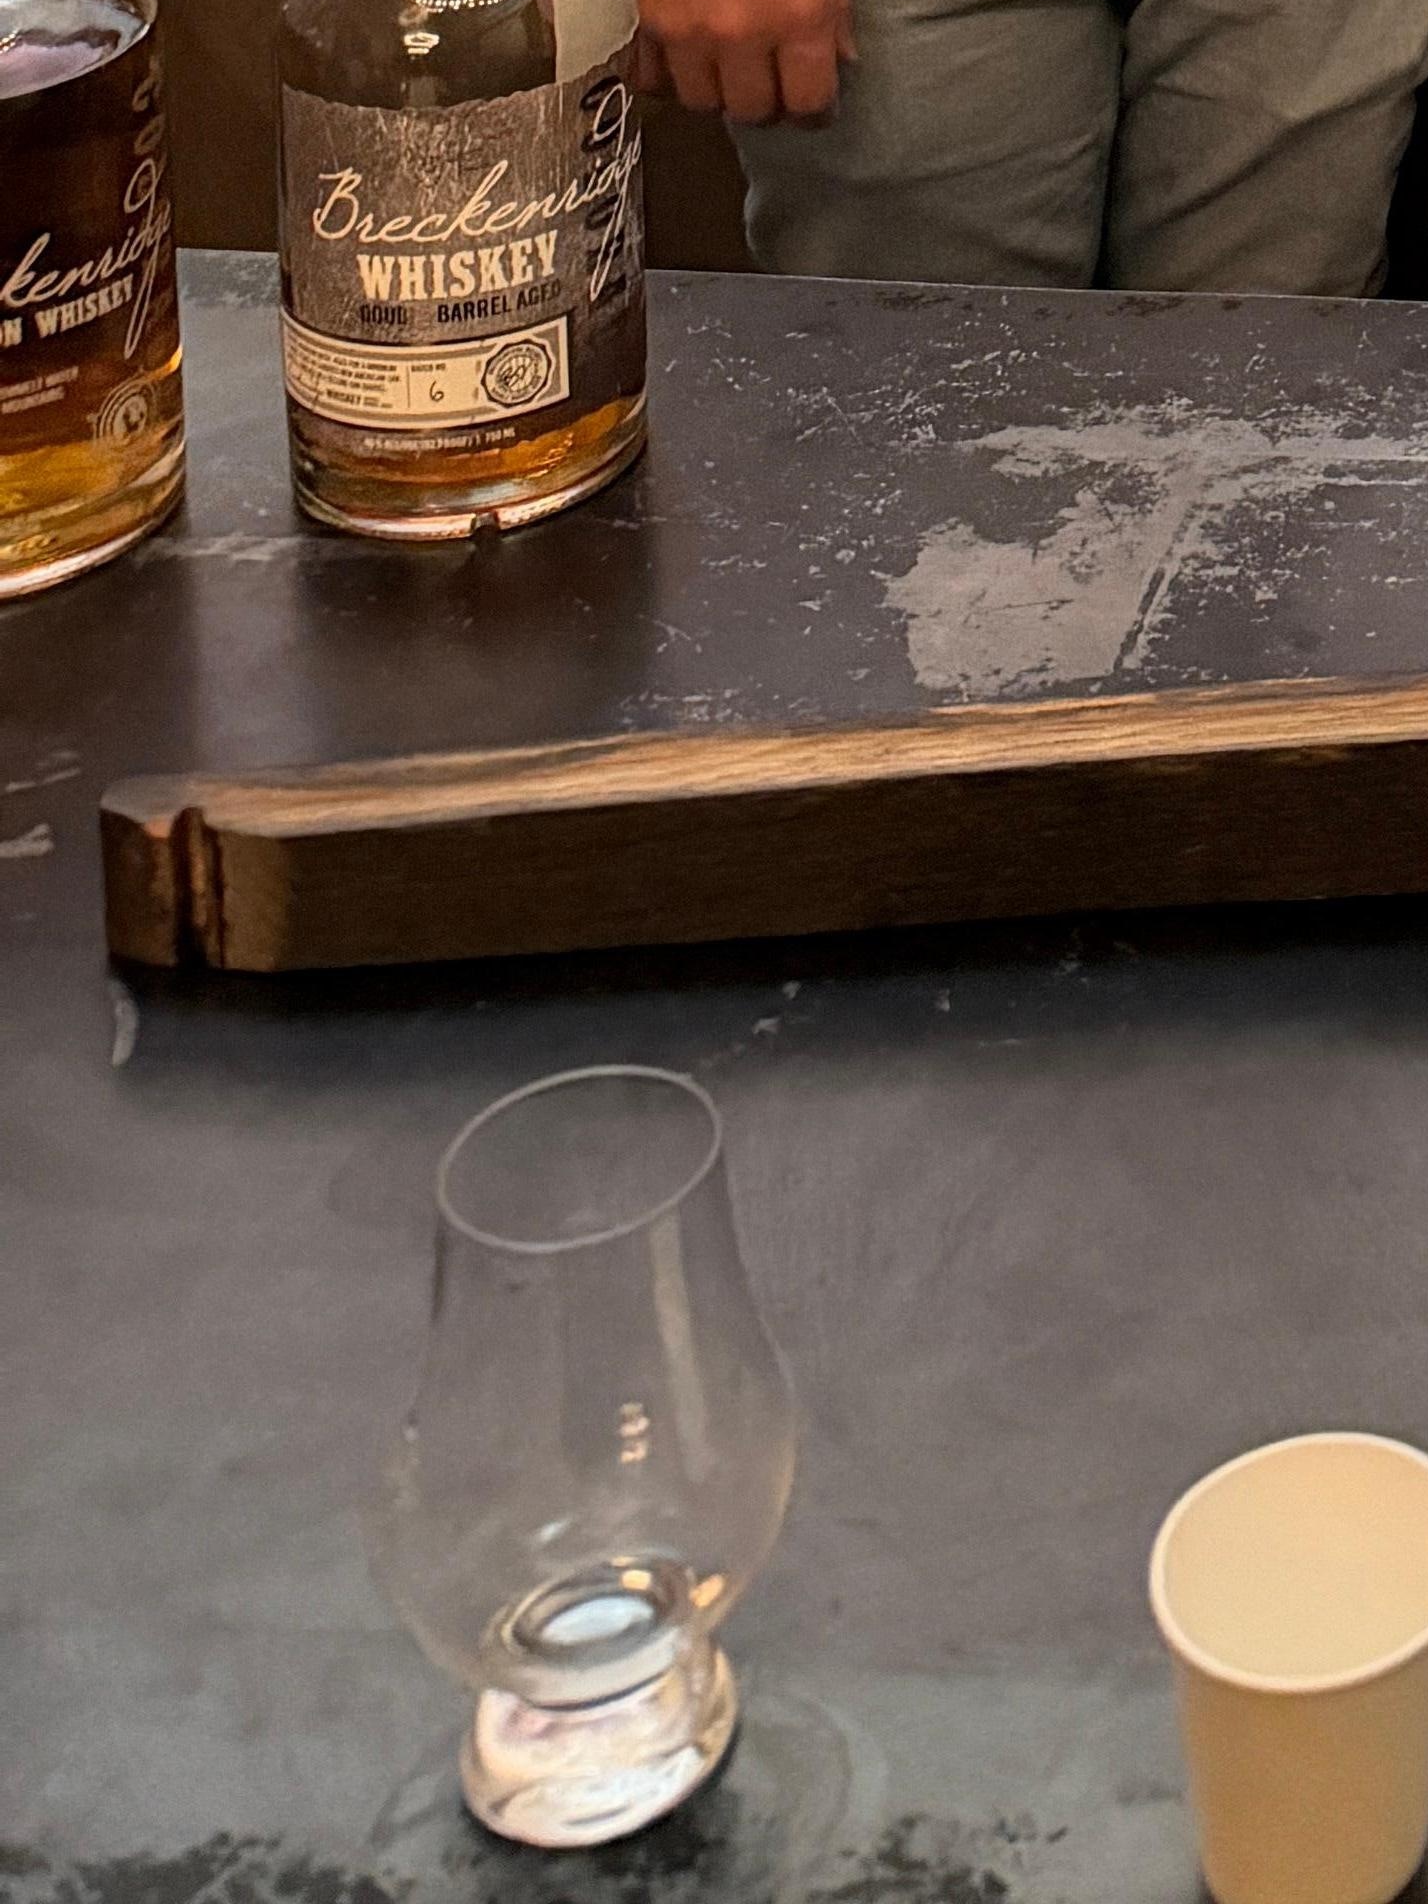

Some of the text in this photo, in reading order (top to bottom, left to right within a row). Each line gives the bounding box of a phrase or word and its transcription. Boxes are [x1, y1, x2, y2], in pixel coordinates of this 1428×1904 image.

[312, 82, 642, 302] Breckenridge
[357, 230, 558, 302] WHISKEY
[34, 273, 134, 338] WHISKEY
[437, 295, 511, 324] BARREL
[429, 380, 445, 403] 6
